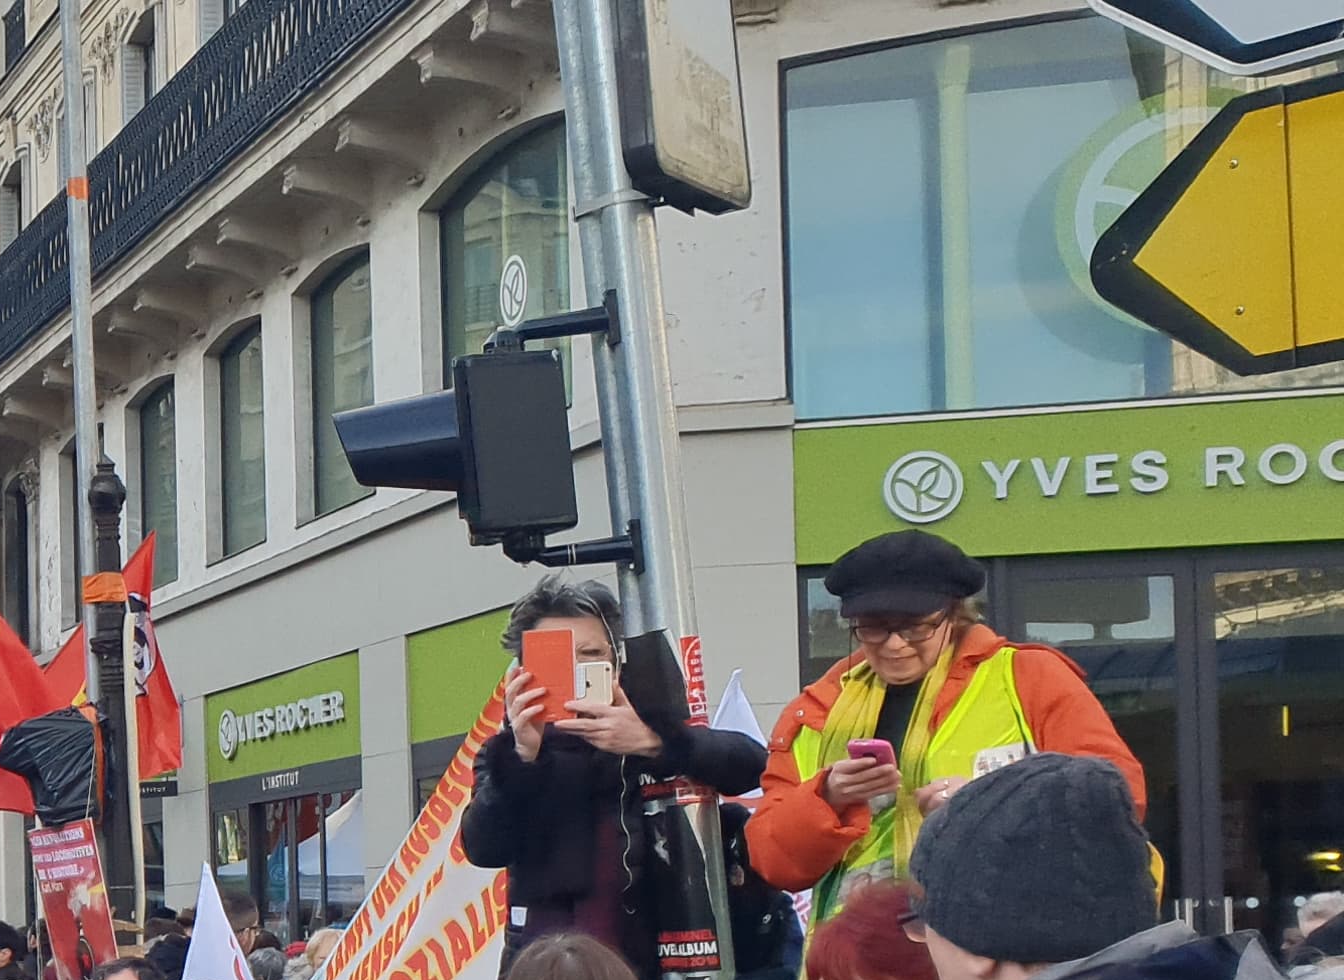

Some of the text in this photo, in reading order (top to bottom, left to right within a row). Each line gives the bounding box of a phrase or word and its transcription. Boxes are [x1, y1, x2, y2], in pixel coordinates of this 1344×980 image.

[981, 449, 1171, 500] YVES
[237, 708, 275, 743] YVES
[275, 690, 346, 735] ROCHER
